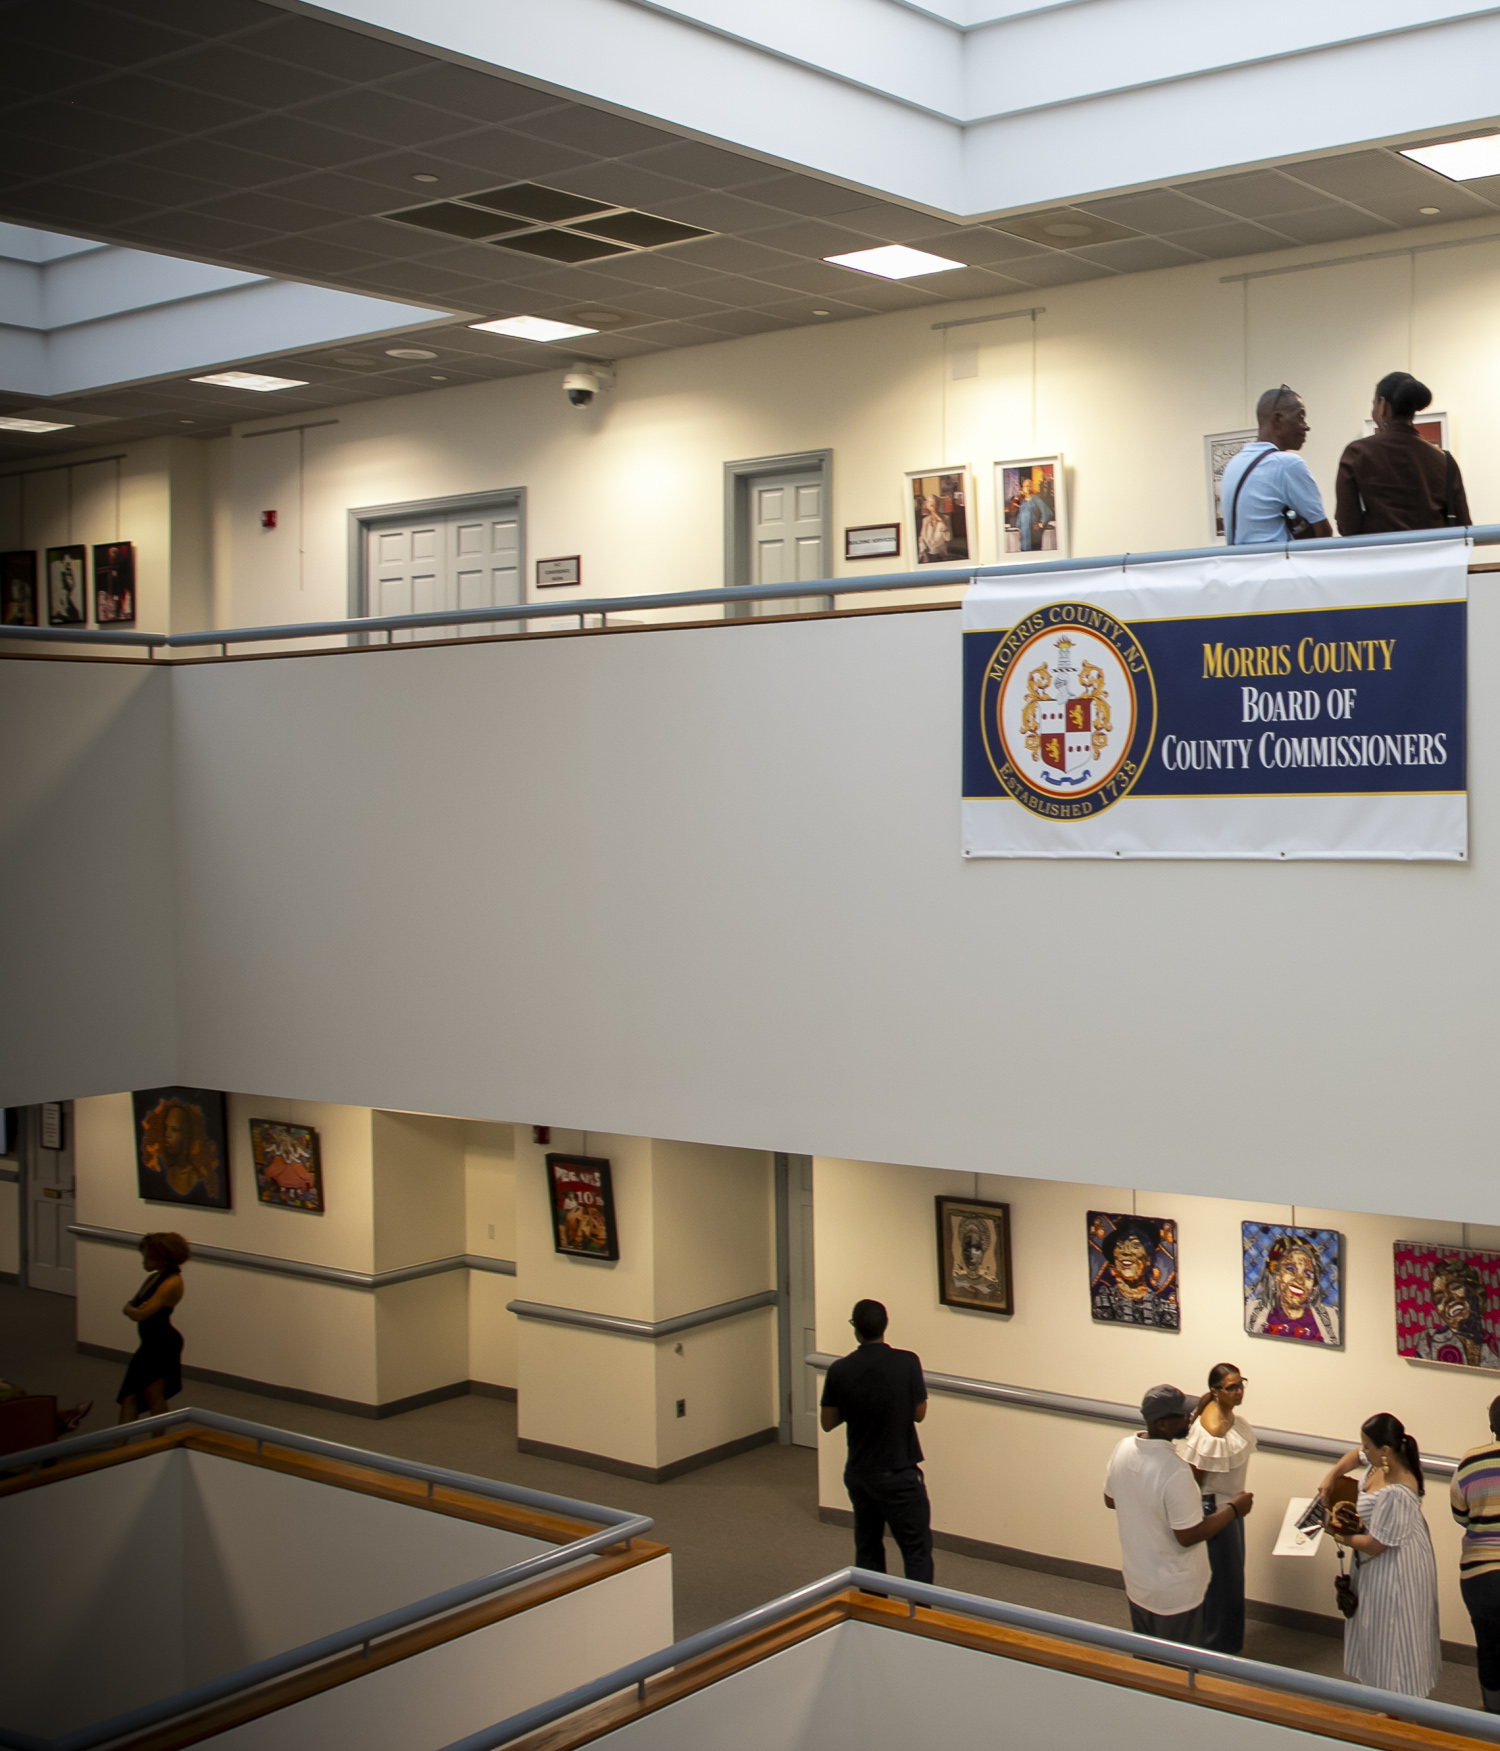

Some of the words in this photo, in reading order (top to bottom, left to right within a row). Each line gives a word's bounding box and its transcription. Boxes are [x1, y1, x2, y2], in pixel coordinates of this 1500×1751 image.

[989, 613, 1045, 681] MORRIS
[1049, 605, 1124, 648] COUNTY,
[1123, 645, 1146, 673] NJ
[1201, 642, 1292, 679] MORRIS
[1297, 637, 1397, 675] COUNTY
[1240, 686, 1321, 723] BOARD
[1326, 688, 1357, 720] OF
[1161, 734, 1254, 771] COUNTY
[1258, 731, 1448, 769] COMMISSIONERS
[999, 761, 1093, 817] ESTABLISHED
[1097, 760, 1138, 806] 1738
